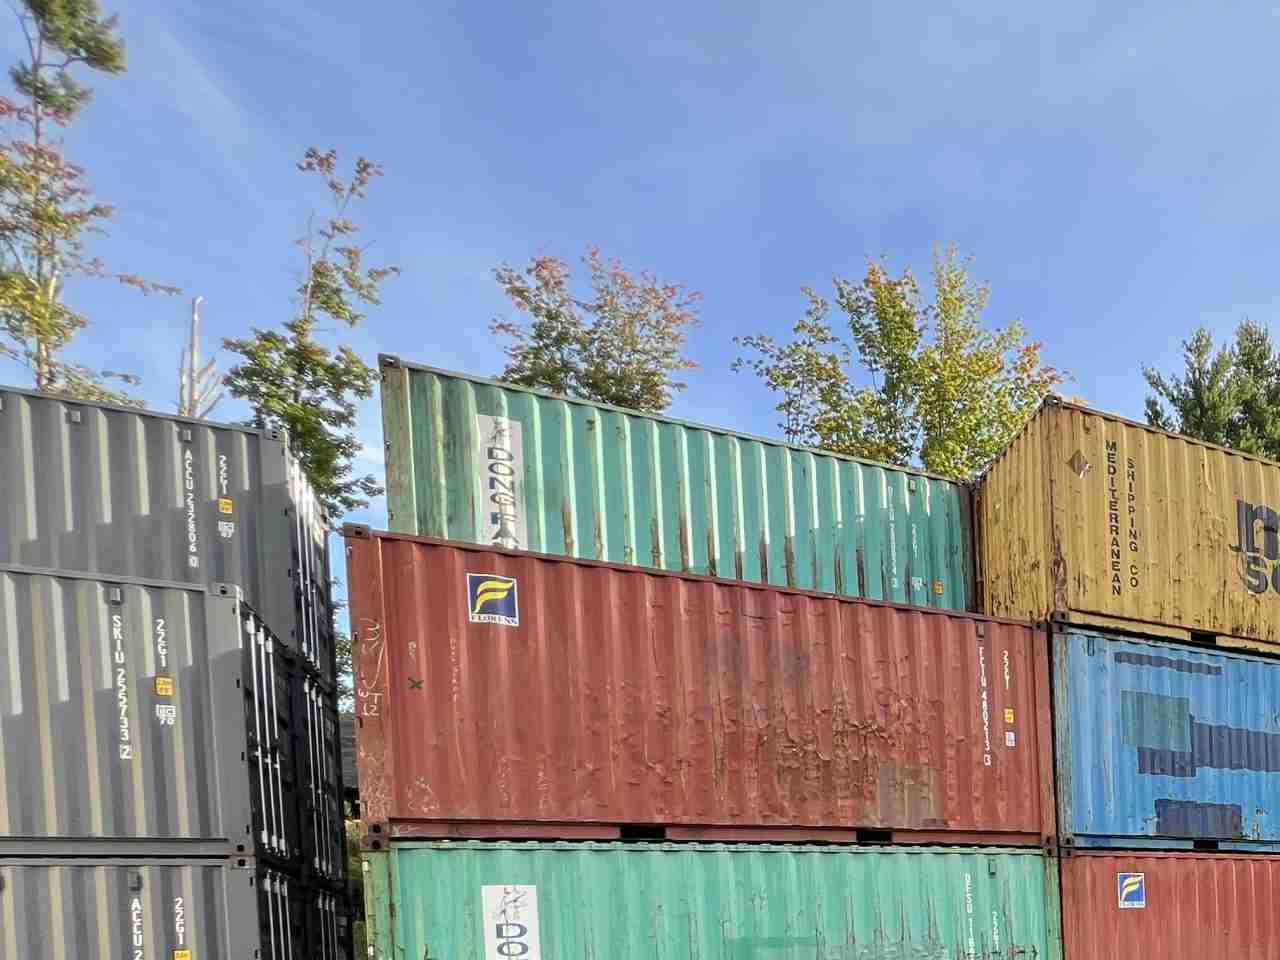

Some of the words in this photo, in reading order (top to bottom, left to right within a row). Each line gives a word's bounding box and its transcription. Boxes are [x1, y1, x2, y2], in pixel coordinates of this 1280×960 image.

[1105, 439, 1122, 597] MEDITERRANEAN
[1126, 457, 1138, 552] SHIPPING
[1129, 564, 1139, 588] CO
[112, 614, 125, 664] SKIU
[155, 618, 167, 667] 22G1
[116, 668, 129, 742] 255733
[131, 898, 144, 947] ACCU
[174, 897, 186, 945] 22G1
